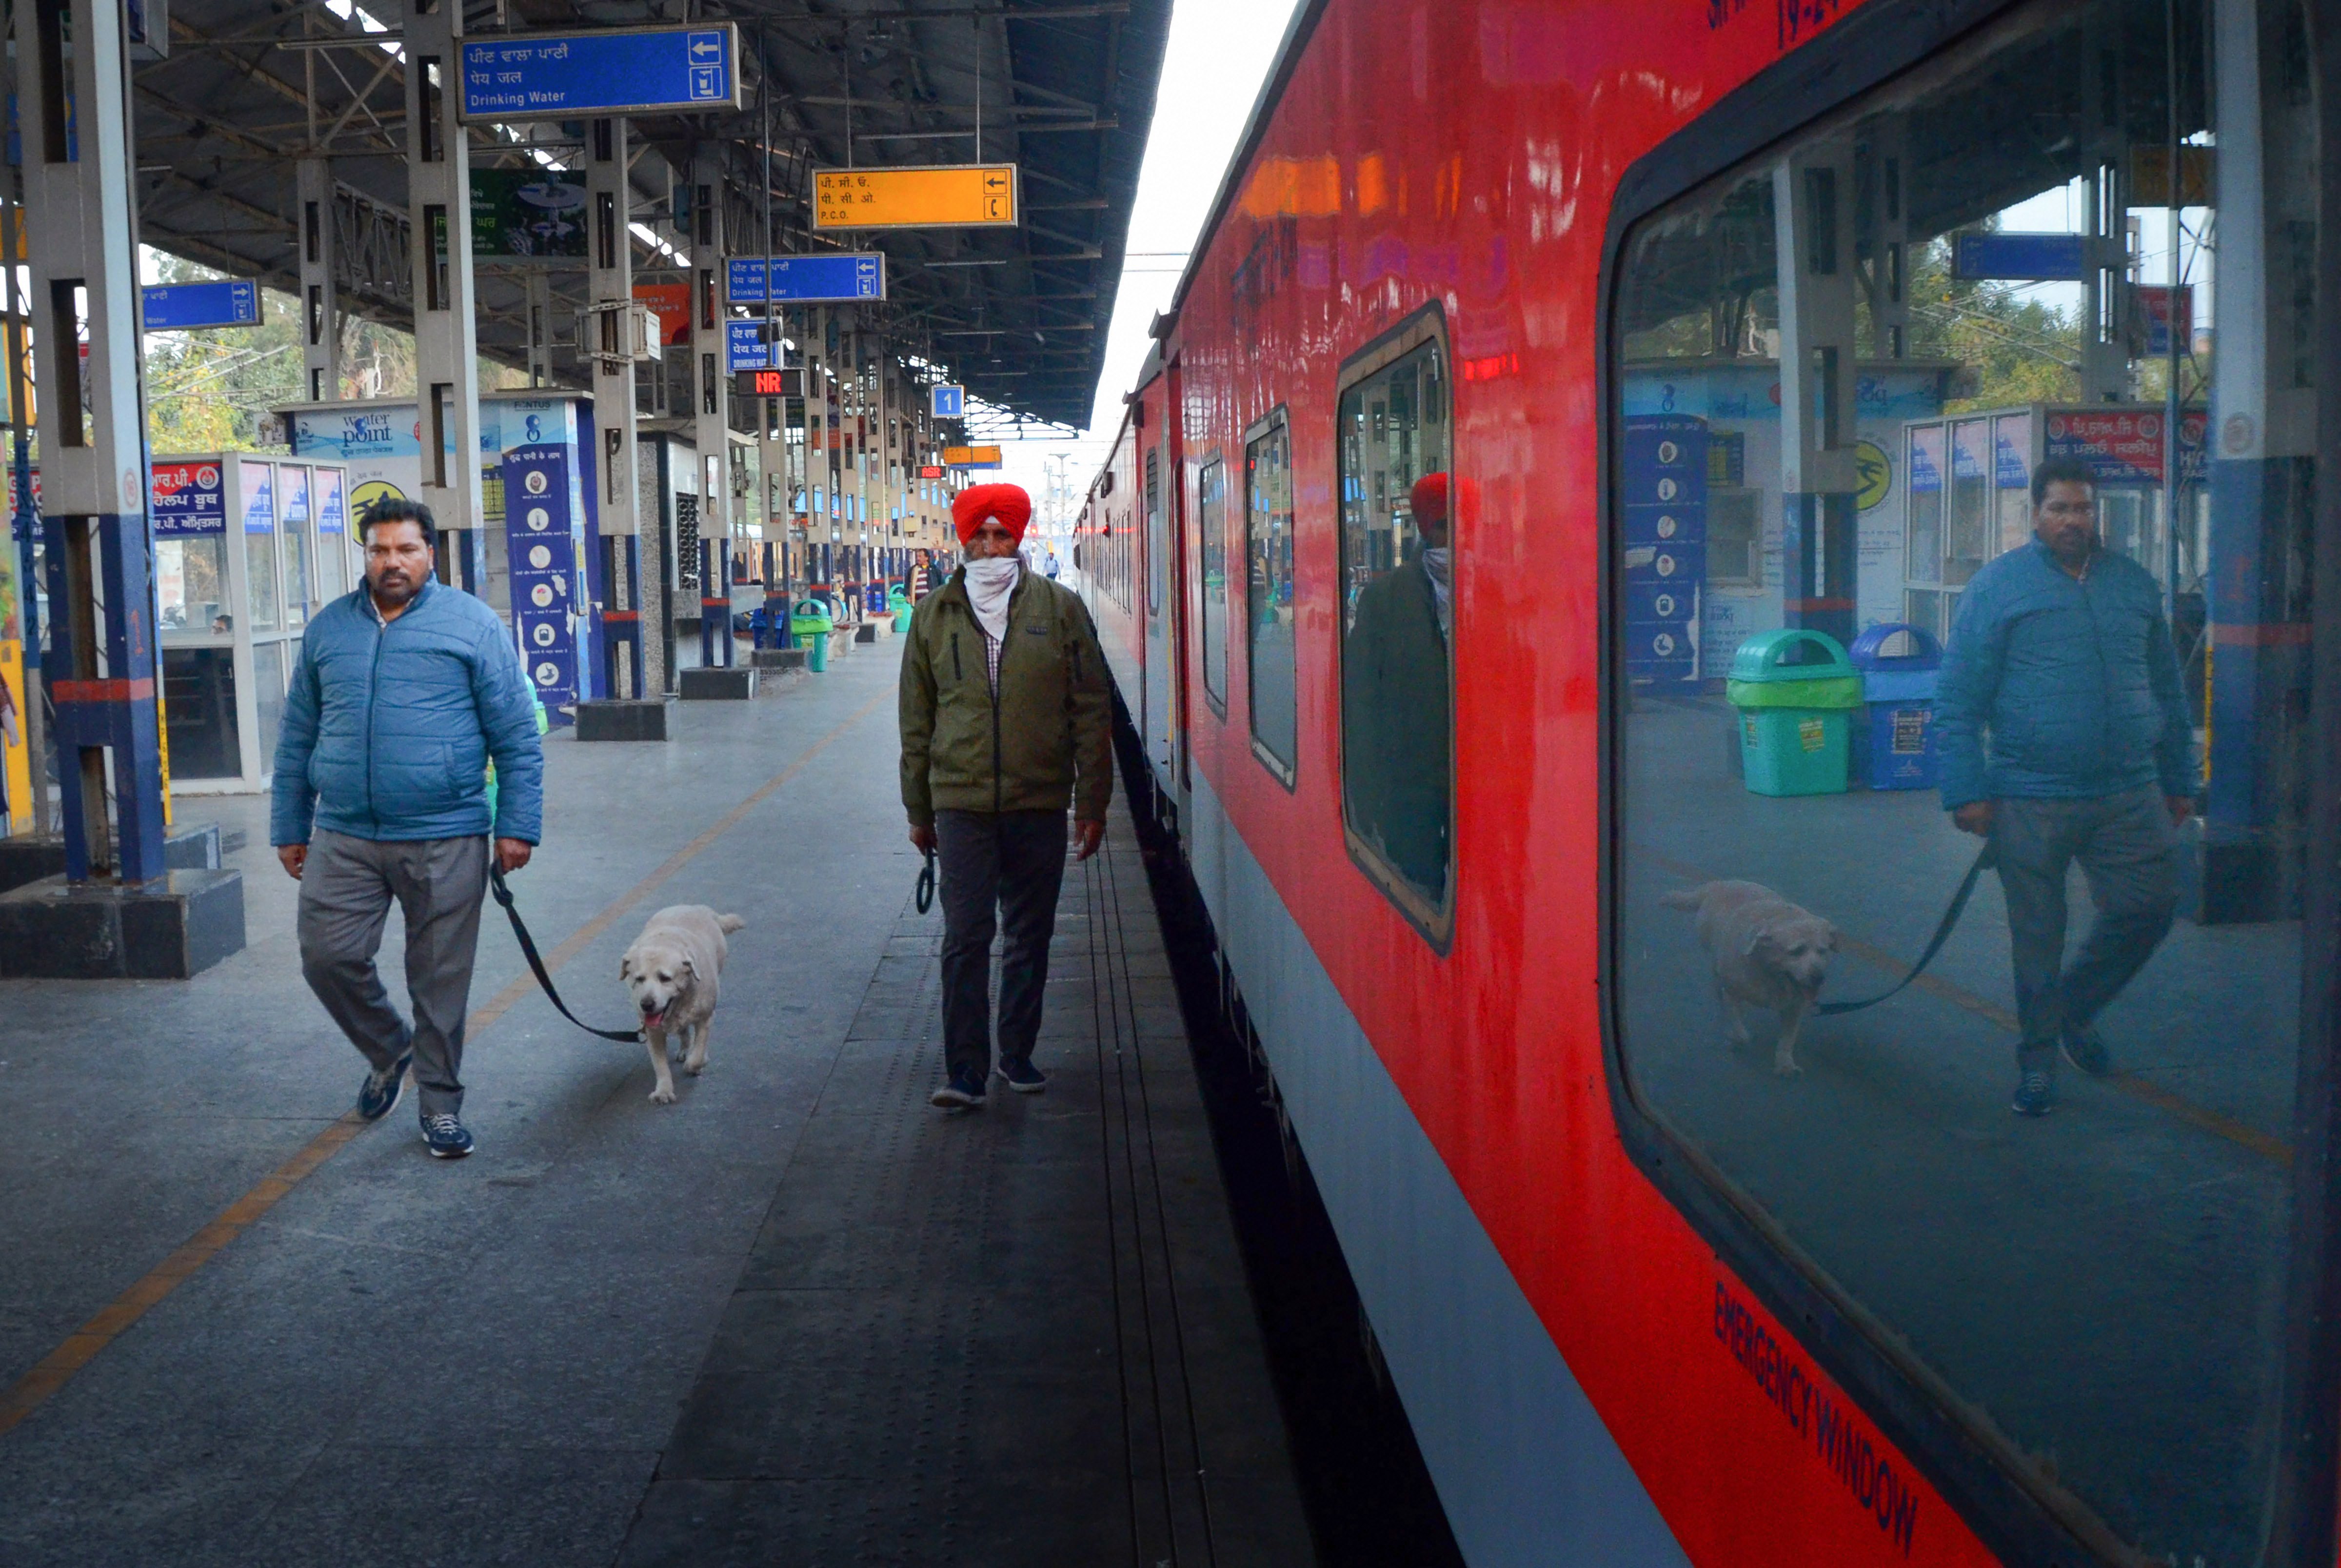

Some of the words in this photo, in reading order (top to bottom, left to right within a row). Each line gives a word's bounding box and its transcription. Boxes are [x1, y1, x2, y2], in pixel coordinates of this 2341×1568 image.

[471, 71, 490, 85] पेय
[497, 72, 522, 83] जल
[471, 93, 524, 106] Drinking
[529, 91, 565, 103] Water
[733, 275, 744, 284] पेय
[732, 289, 763, 297] Drinking
[733, 343, 750, 354] पेय
[755, 372, 781, 394] NR
[943, 392, 952, 411] 1
[343, 425, 393, 448] point
[921, 467, 941, 478] ASR
[1715, 1280, 1812, 1440] EMERGENCY
[1816, 1388, 1918, 1559] WINDOW
